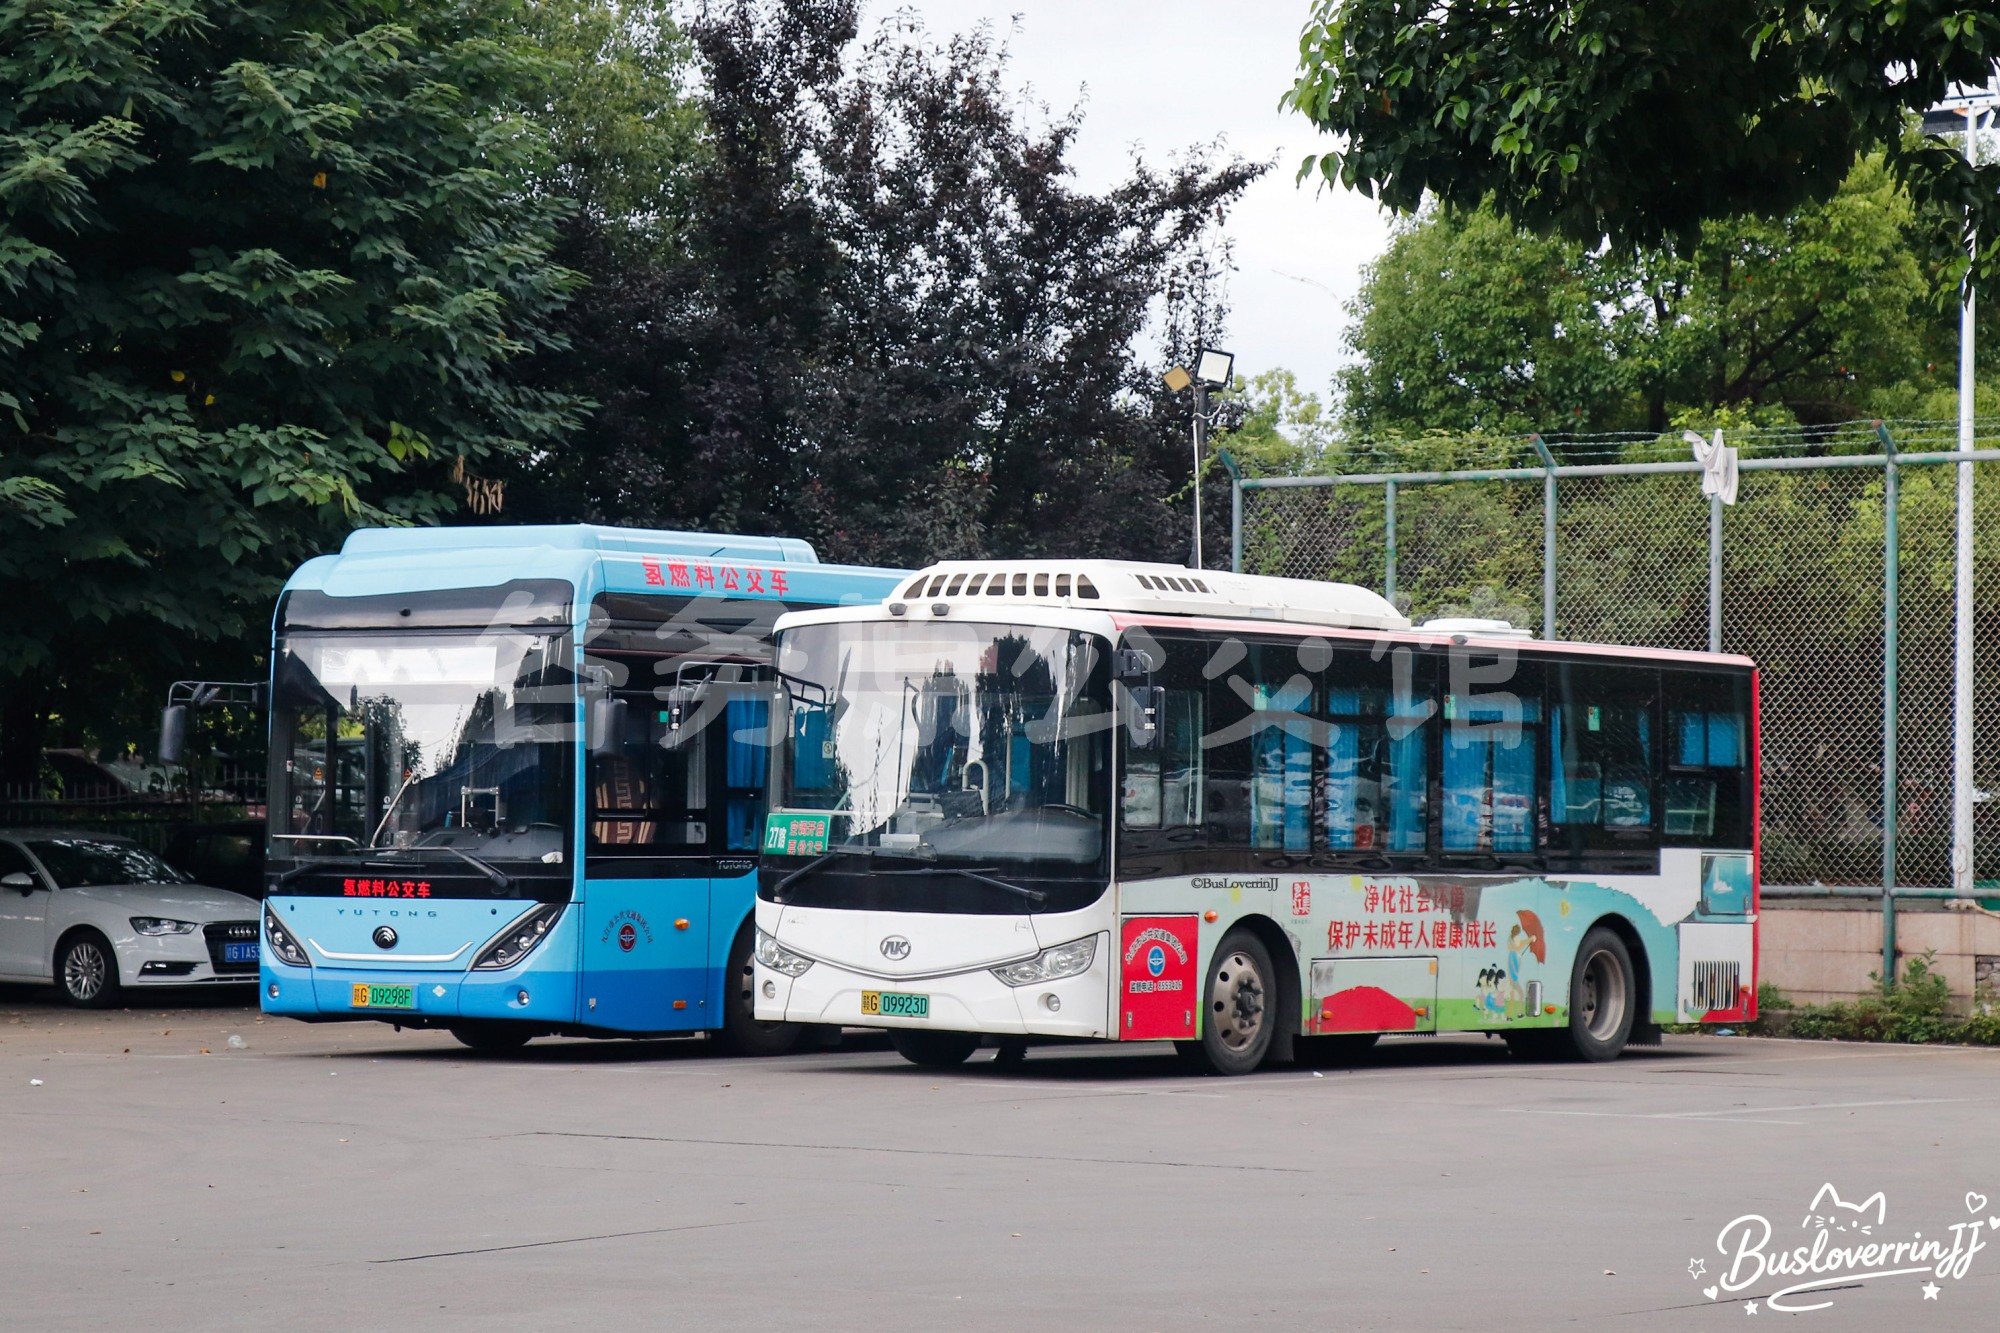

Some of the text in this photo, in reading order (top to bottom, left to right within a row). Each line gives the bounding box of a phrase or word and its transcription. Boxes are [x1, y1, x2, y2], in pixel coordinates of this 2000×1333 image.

[642, 555, 790, 597] 氢燃料公交车
[767, 826, 786, 849] 27路
[343, 878, 431, 898] 氢燃料公交车
[337, 908, 438, 918] YUTONG
[1328, 920, 1497, 950] 保护未成年人健康成长
